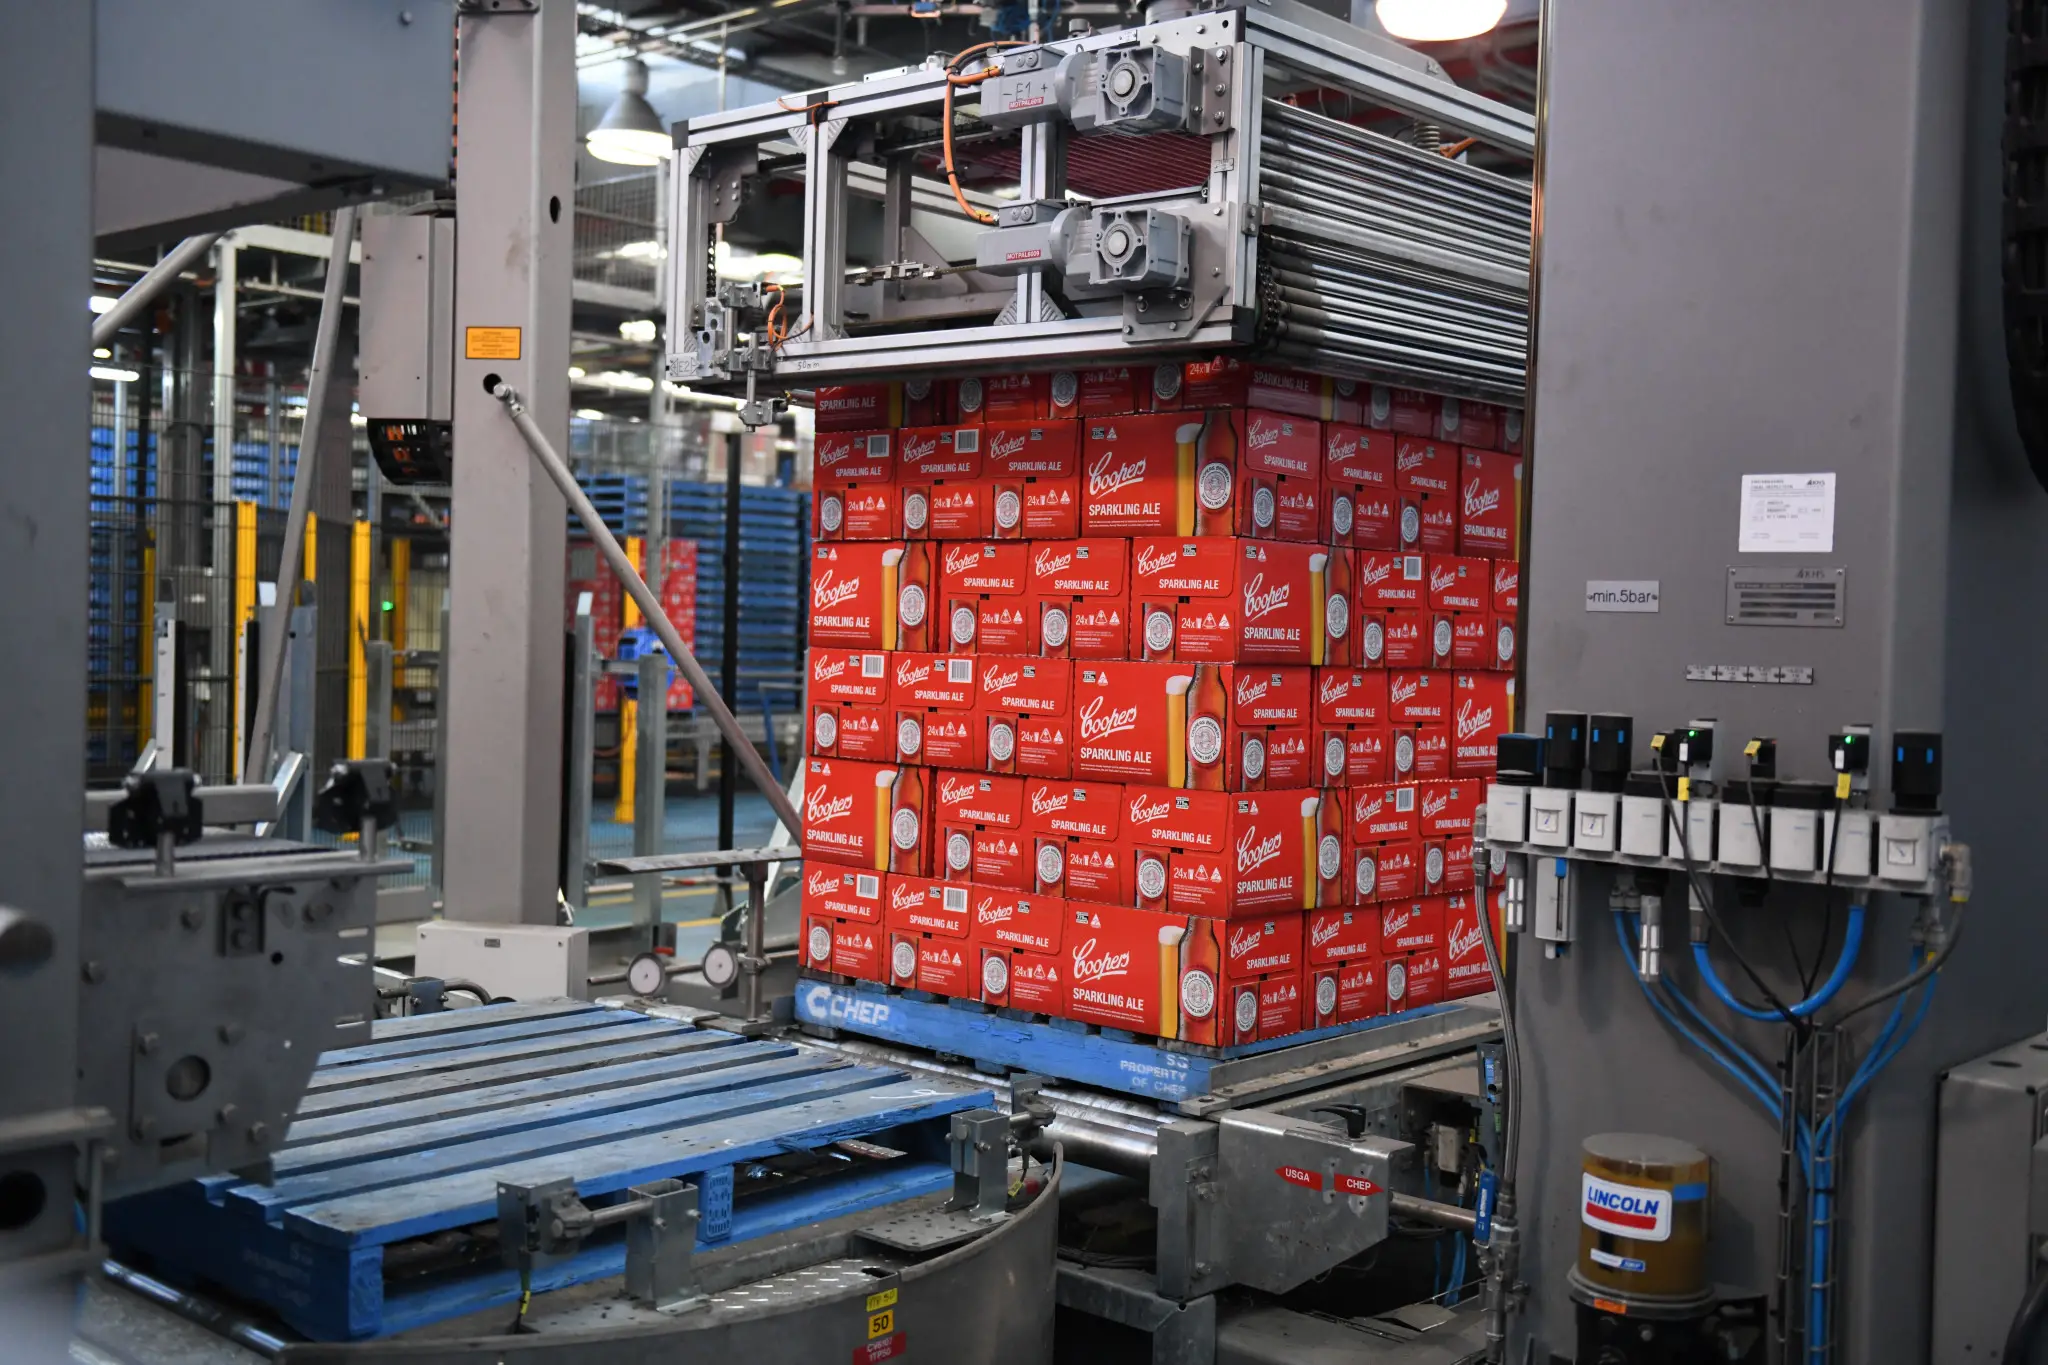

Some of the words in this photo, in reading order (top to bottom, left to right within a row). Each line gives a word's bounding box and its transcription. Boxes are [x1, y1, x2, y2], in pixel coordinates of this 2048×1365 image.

[1253, 372, 1295, 389] SPARKLING
[1296, 379, 1309, 391] ALE
[820, 398, 859, 411] SPARKLING
[862, 397, 876, 407] ALE
[921, 464, 956, 474] SPARKLING
[958, 463, 970, 471] ALE
[1009, 462, 1047, 471] SPARKLING
[1048, 462, 1061, 471] ALE
[1264, 455, 1295, 469] SPARKLING
[1296, 460, 1308, 471] ALE
[836, 467, 868, 477] SPARKLING
[870, 467, 881, 475] ALE
[1089, 452, 1146, 499] Coopers
[1343, 467, 1372, 480] SPARKLING
[1373, 472, 1382, 482] ALE
[1089, 504, 1140, 516] SPARKLING
[1142, 503, 1160, 515] ALE
[1464, 524, 1495, 537] SPARKLING
[1496, 528, 1507, 539] ALE
[946, 547, 979, 575] Coopers
[1036, 548, 1071, 578] Coopers
[1138, 545, 1176, 576] Coopers
[814, 569, 859, 611] Coopers
[964, 578, 1000, 588] SPARKLING
[1002, 578, 1014, 588] ALE
[1055, 580, 1093, 590] SPARKLING
[1095, 580, 1109, 590] ALE
[1159, 579, 1202, 589] SPARKLING
[1204, 579, 1218, 589] ALE
[1244, 573, 1289, 622] Coopers
[1378, 589, 1404, 598] SPARKLING
[1406, 590, 1415, 598] ALE
[814, 616, 854, 627] SPARKLING
[856, 617, 869, 628] ALE
[1244, 627, 1285, 640] SPARKLING
[1287, 629, 1300, 640] ALE
[814, 655, 845, 681] Coopers
[897, 659, 929, 686] Coopers
[984, 665, 1018, 694] Coopers
[831, 684, 863, 694] SPARKLING
[865, 686, 876, 695] ALE
[915, 690, 950, 700] SPARKLING
[952, 692, 964, 701] ALE
[1002, 697, 1039, 708] SPARKLING
[1042, 699, 1054, 710] ALE
[1080, 696, 1136, 743] Coopers
[1254, 709, 1285, 718] SPARKLING
[1287, 709, 1297, 718] ALE
[1336, 708, 1364, 717] SPARKLING
[1365, 708, 1375, 717] ALE
[1457, 699, 1492, 742] Coopers
[1081, 748, 1131, 761] SPARKLING
[1134, 751, 1151, 763] ALE
[1457, 746, 1487, 758] SPARKLING
[942, 777, 974, 806] Coopers
[808, 784, 852, 826] Coopers
[1032, 787, 1068, 816] Coopers
[960, 809, 995, 822] SPARKLING
[997, 813, 1010, 823] ALE
[1130, 794, 1169, 825] Coopers
[1052, 820, 1090, 832] SPARKLING
[1092, 824, 1106, 834] ALE
[1370, 822, 1397, 834] SPARKLING
[1398, 821, 1408, 831] ALE
[1435, 819, 1460, 829] SPARKLING
[1461, 819, 1470, 827] ALE
[807, 829, 847, 844] SPARKLING
[849, 834, 863, 846] ALE
[1152, 829, 1194, 842] SPARKLING
[1196, 834, 1211, 844] ALE
[1237, 826, 1281, 876] Coopers
[809, 870, 839, 898] Coopers
[1237, 878, 1277, 894] SPARKLING
[1279, 876, 1292, 888] ALE
[892, 883, 924, 911] Coopers
[825, 901, 857, 914] SPARKLING
[859, 906, 870, 916] ALE
[978, 897, 1012, 926] Coopers
[910, 914, 945, 928] SPARKLING
[947, 920, 959, 930] ALE
[996, 930, 1034, 944] SPARKLING
[1036, 936, 1049, 947] ALE
[1397, 936, 1423, 947] SPARKLING
[1424, 934, 1433, 943] ALE
[1327, 946, 1355, 957] SPARKLING
[1357, 943, 1366, 953] ALE
[1073, 938, 1129, 983] Coopers
[1246, 956, 1279, 969] SPARKLING
[1280, 954, 1290, 964] ALE
[1449, 964, 1480, 978] SPARKLING
[1073, 988, 1124, 1006] SPARKLING
[1126, 997, 1144, 1011] ALE
[830, 994, 890, 1025] CHEP
[1120, 1060, 1187, 1082] PROPERTY
[1132, 1076, 1148, 1088] OF
[1286, 1168, 1310, 1182] USGA
[1347, 1179, 1371, 1190] CHEP
[1588, 1186, 1660, 1215] LINCOLN
[872, 1315, 889, 1332] 50
